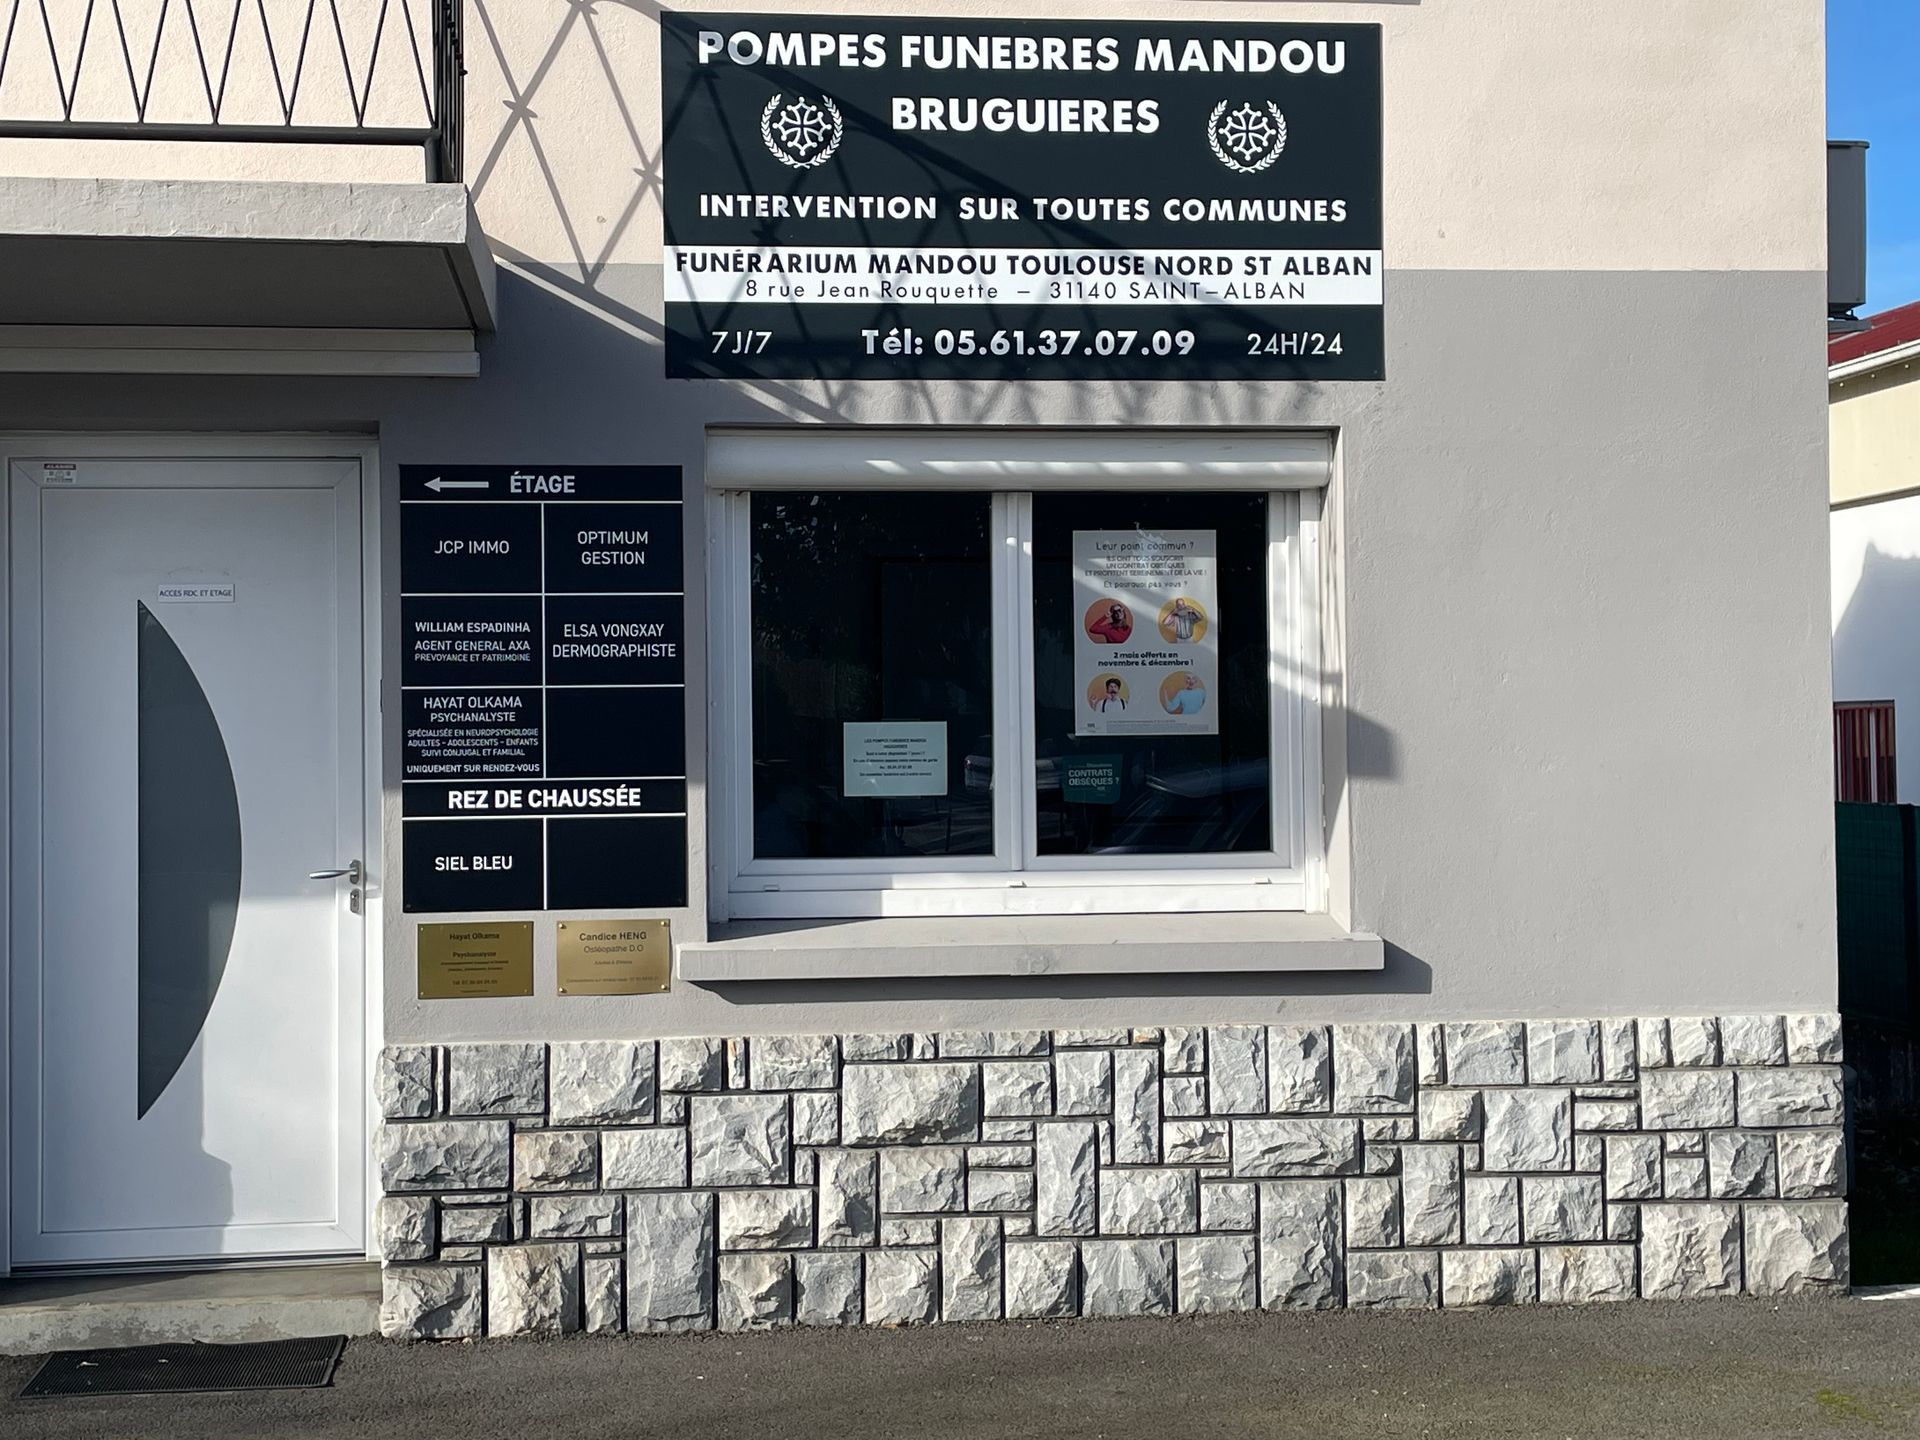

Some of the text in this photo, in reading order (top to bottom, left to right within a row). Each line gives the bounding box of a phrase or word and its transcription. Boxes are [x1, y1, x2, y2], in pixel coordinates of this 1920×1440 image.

[698, 30, 1346, 74] POMPES FUNEBRES MANDOU
[891, 97, 1160, 134] BRUGUIERES
[700, 194, 1347, 222] INTERVENTION SUR TOUTES COMMUNES
[676, 249, 1372, 276] FUNÉRARIUM MANDOU TOULOUSE NORD ST ALBAN
[745, 280, 758, 297] 8
[768, 285, 805, 298] rue
[817, 280, 869, 298] Jean
[880, 281, 998, 304] Rouquette
[1049, 281, 1117, 299] 31140
[861, 328, 1195, 356] Tél: 05.61.37.07.09
[1247, 331, 1343, 356] 24H/24
[510, 471, 576, 494] ÉTAGE
[577, 531, 649, 545] OPTIMUM
[434, 540, 510, 554] JCP IMMO
[1096, 542, 1118, 551] Leur
[1120, 542, 1144, 552] point
[1147, 542, 1187, 551] commun
[581, 551, 645, 565] GESTION
[415, 622, 531, 633] WILLIAM ESPADINHA
[564, 623, 665, 638] ELSA VONGXAY
[414, 640, 531, 651] AGENT GENERAL AXA
[552, 643, 677, 658] DERMOGRAPHISTE
[414, 653, 531, 662] PREVOYANCE ET PATRIMOINE
[1113, 651, 1119, 659] 2
[1119, 651, 1140, 659] mois
[1140, 651, 1167, 659] offerts
[1098, 659, 1140, 667] novembre
[423, 696, 523, 709] HAYAT OLKAMA
[430, 711, 516, 722] PSYCHANALYSTE
[407, 728, 539, 737] SPÉCIALISÉE EN NEUROPSYCHOLOGIE
[407, 739, 441, 747] ADULTES
[447, 738, 499, 746] ADOLESCENTS
[505, 738, 539, 746] ENFANTS
[421, 748, 526, 757] SUIVI CONJUGAL ET FAMILIAL
[406, 763, 540, 773] UNIQUEMENT SUR RENDEZ-VOUS
[1068, 768, 1113, 777] CONTRATS
[448, 784, 641, 809] REZ DE CHAUSSÉE
[434, 855, 513, 871] SIEL BLEU
[579, 931, 647, 941] Candice HENG
